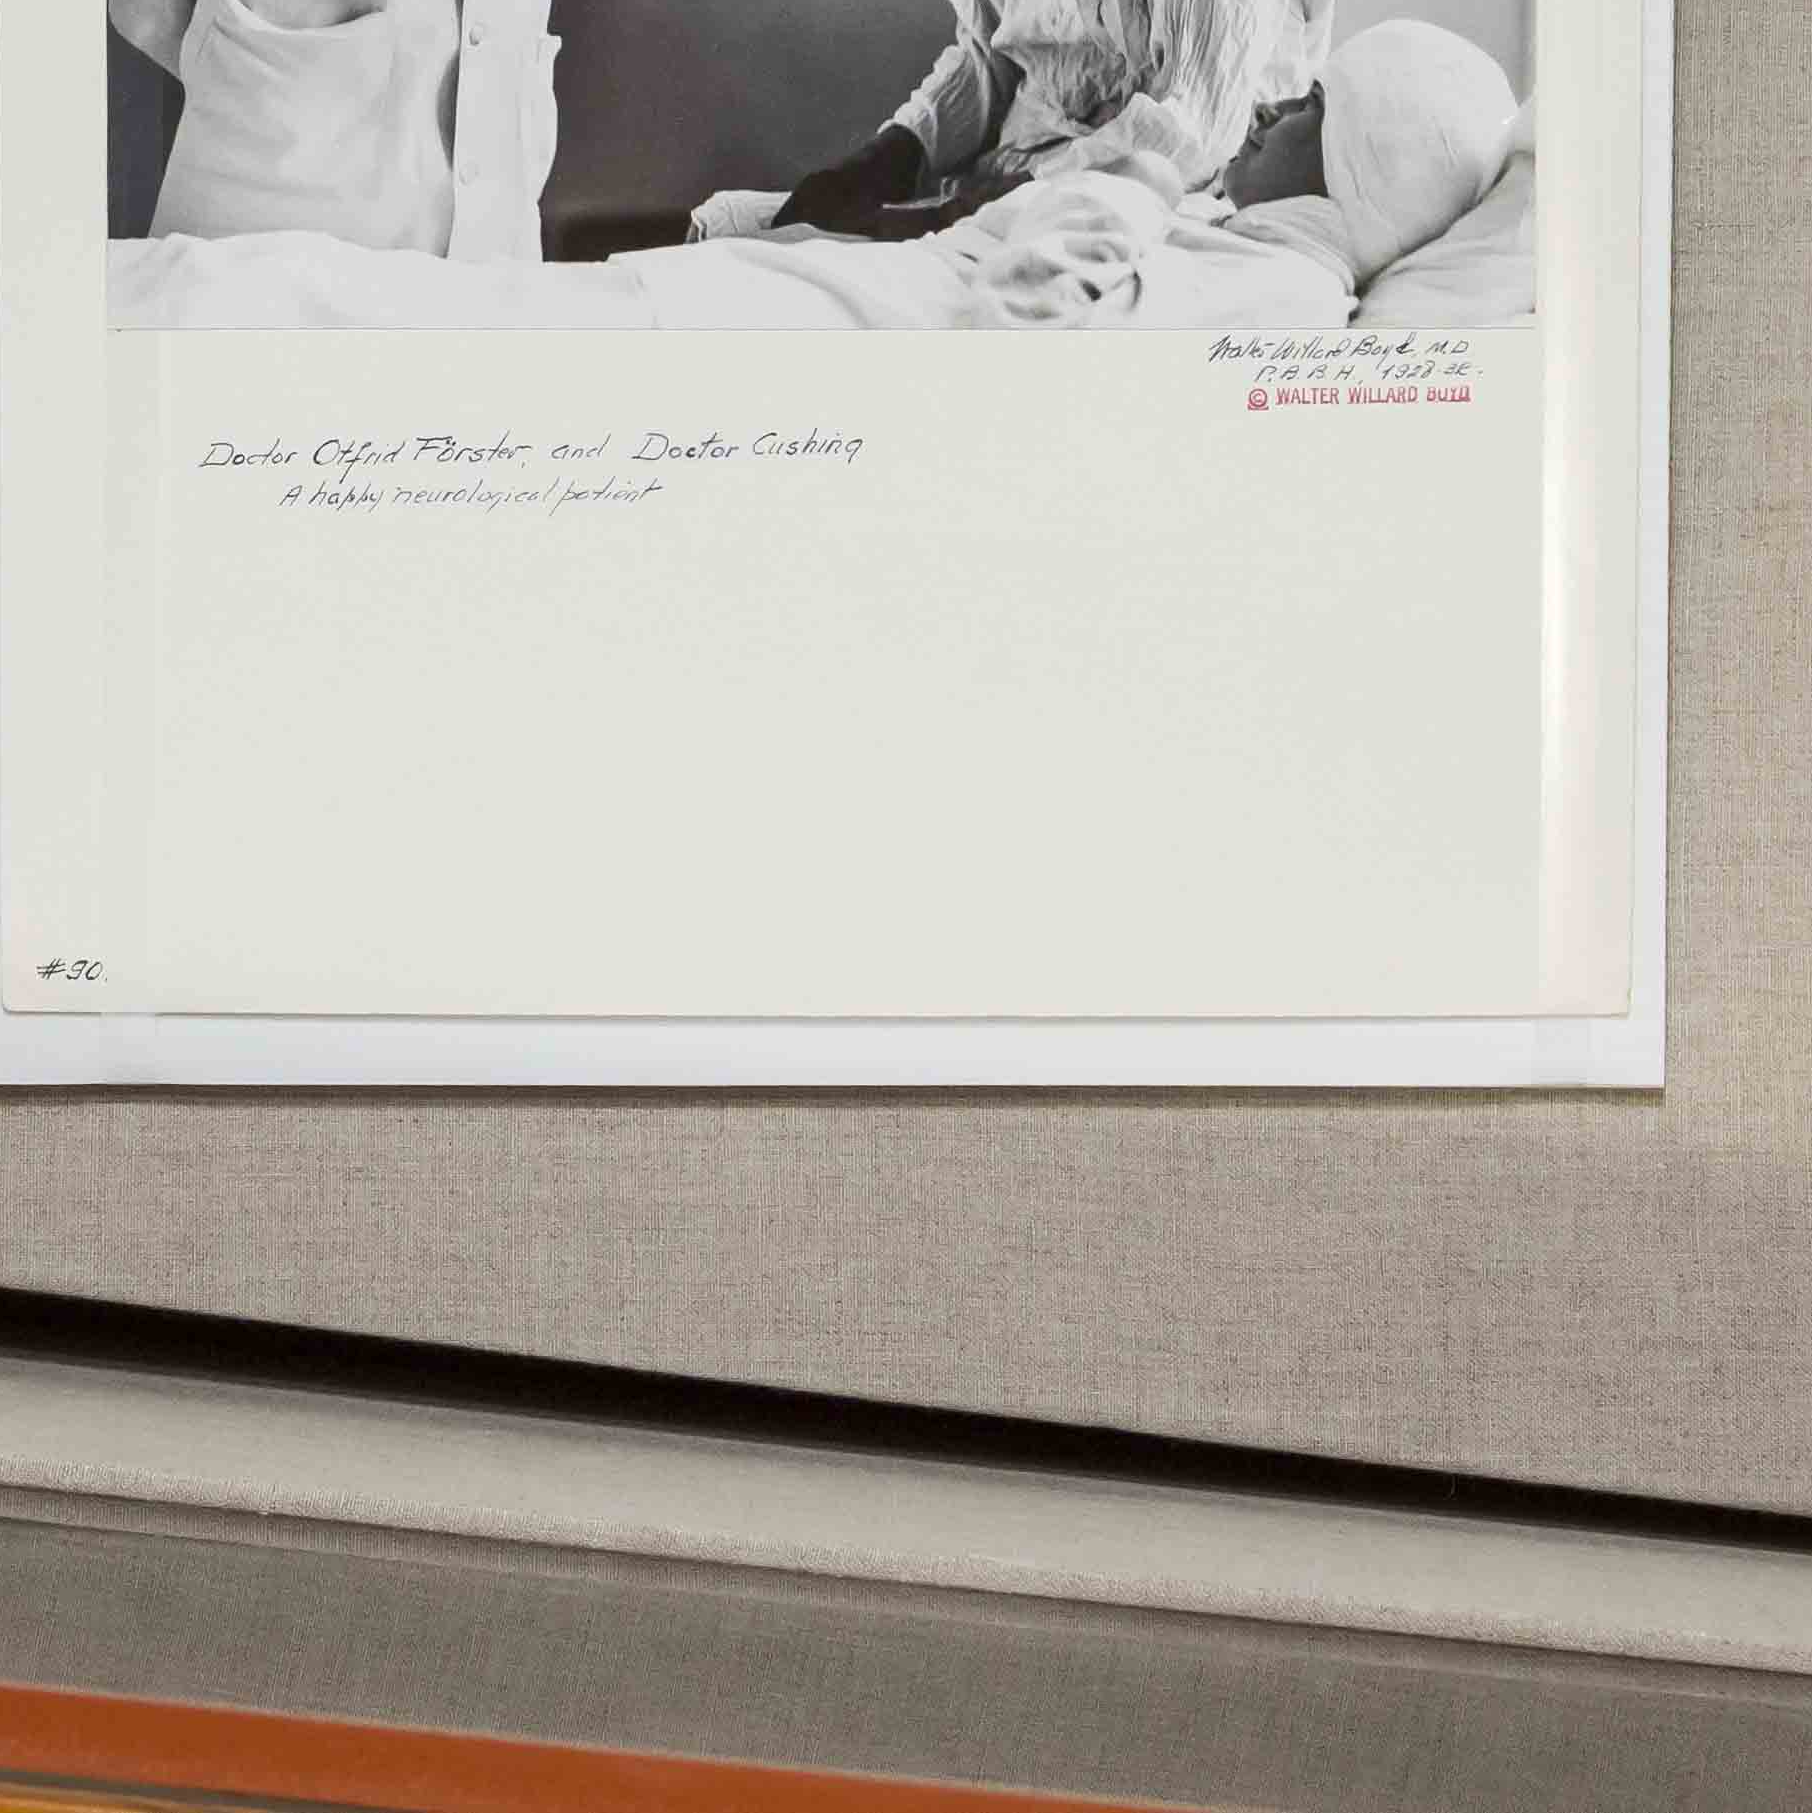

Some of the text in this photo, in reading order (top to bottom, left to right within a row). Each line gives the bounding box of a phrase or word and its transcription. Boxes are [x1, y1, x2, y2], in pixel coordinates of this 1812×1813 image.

[1275, 387, 1340, 405] WALTER
[1347, 386, 1419, 404] WILLARD
[198, 438, 299, 467] Doctor
[551, 432, 612, 460] and
[630, 432, 740, 461] Doctor
[752, 427, 864, 465] Cushing
[279, 476, 664, 517] A happy neurological patient
